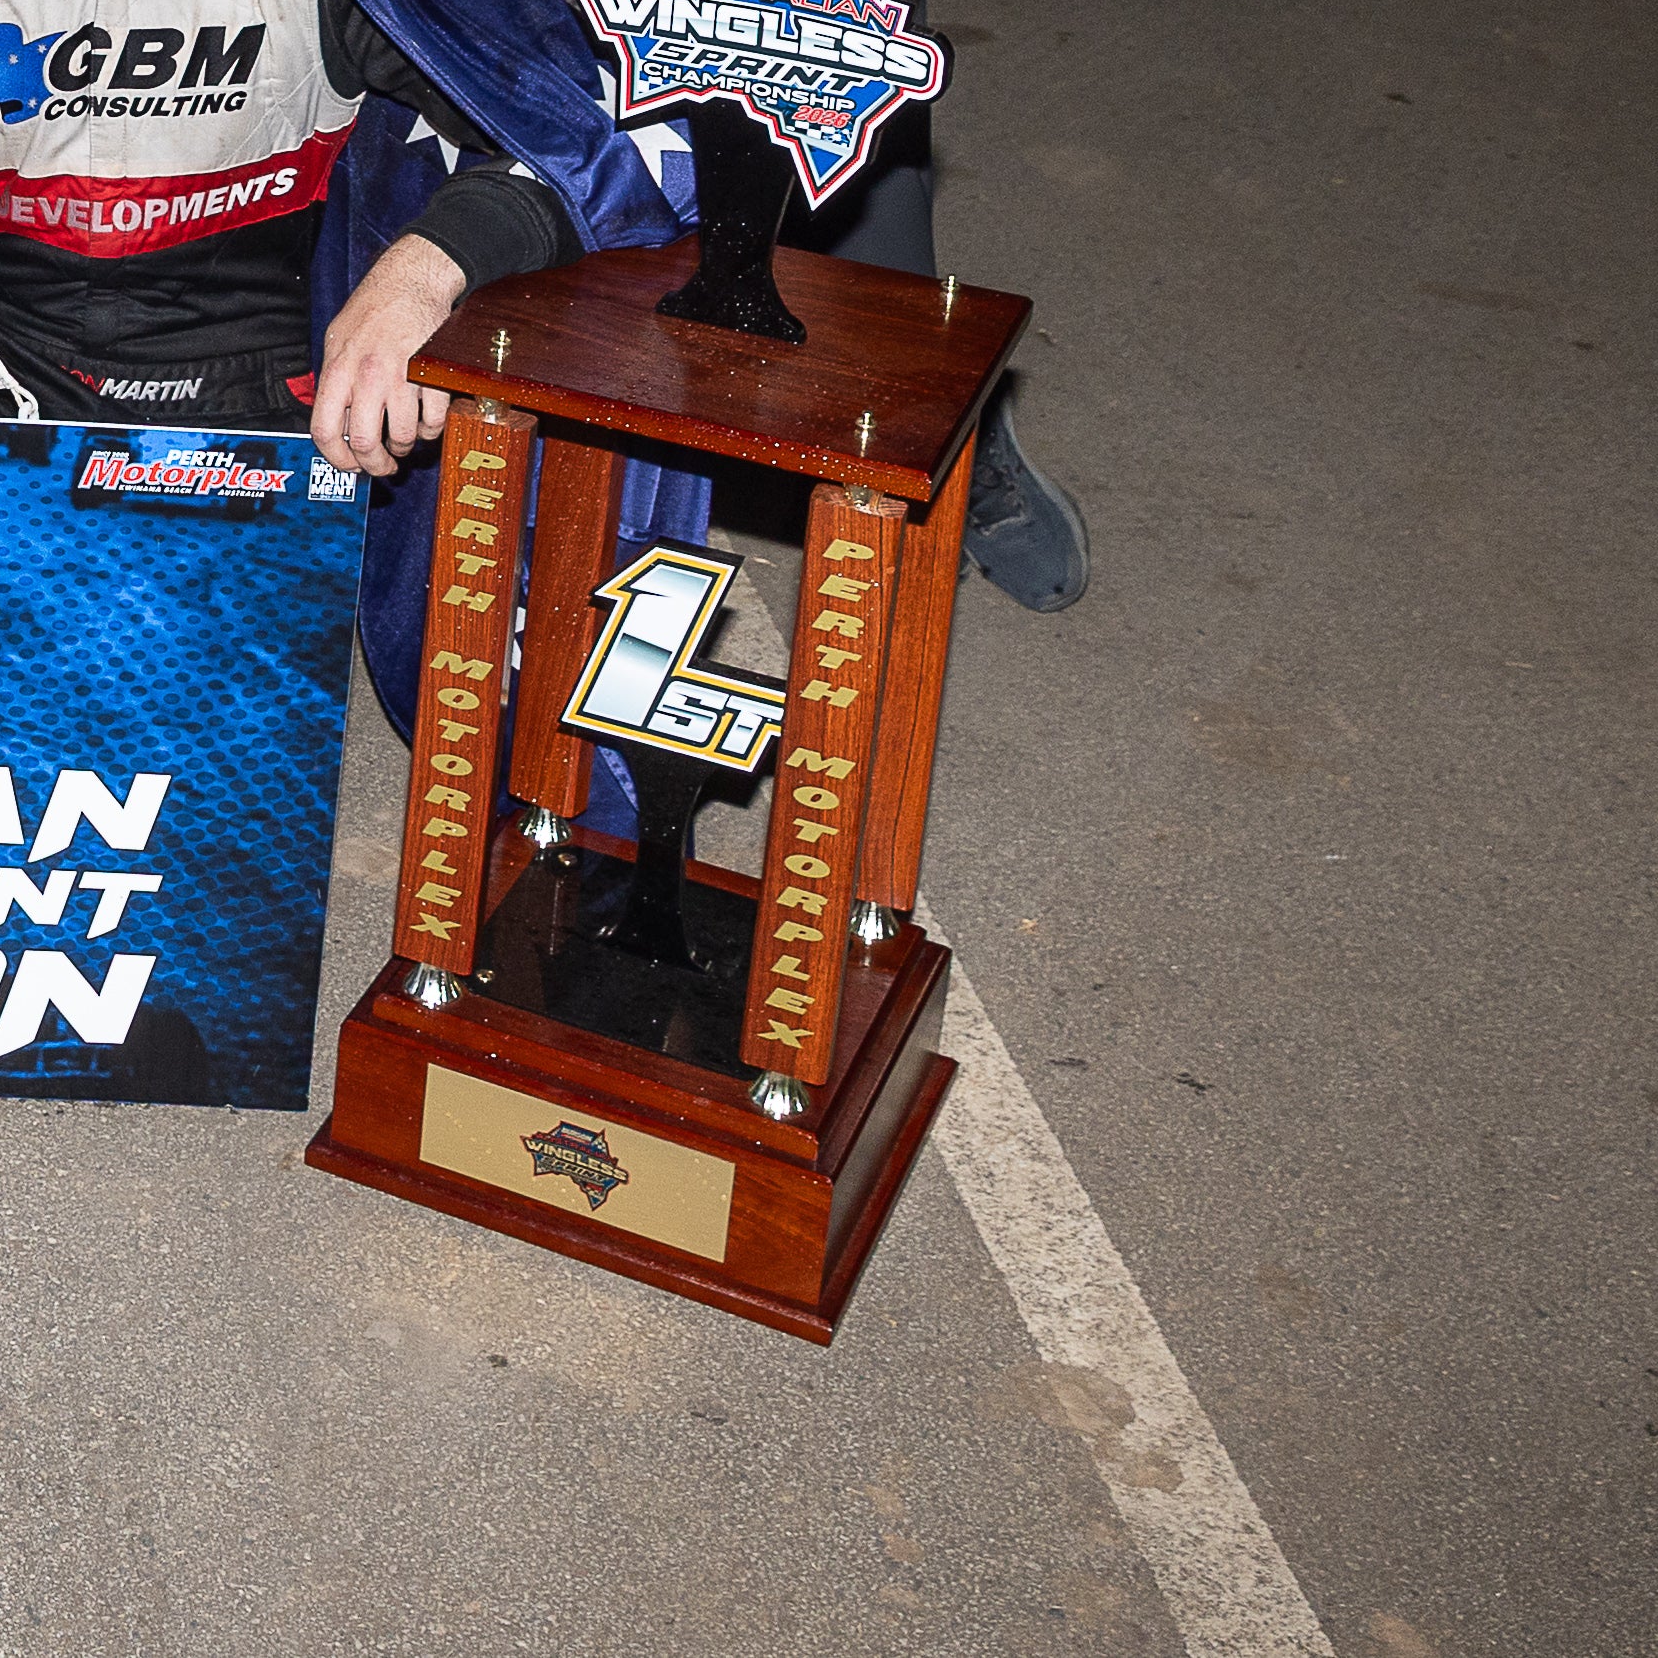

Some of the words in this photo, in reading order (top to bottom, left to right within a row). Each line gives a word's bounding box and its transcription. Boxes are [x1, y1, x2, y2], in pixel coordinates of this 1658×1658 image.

[48, 22, 266, 93] GBM
[645, 39, 872, 96] SPRINT
[44, 90, 249, 121] CONSULTING
[641, 61, 856, 112] CHAMPIONSHIP
[792, 105, 853, 128] 2026
[99, 376, 203, 402] MARTIN
[77, 457, 295, 495] Motorplex
[165, 449, 236, 468] PERTH
[312, 471, 355, 486] TAIN
[118, 484, 163, 494] KWINANA
[163, 485, 193, 494] BEACH
[217, 488, 266, 498] AUSTRALIA
[310, 483, 354, 496] MENT
[440, 448, 508, 614] PERTH
[798, 538, 875, 710] PERTH
[415, 649, 495, 942] MOTORPLEX
[756, 746, 857, 1050] MOTORPLEX
[524, 1138, 628, 1183] WINGLESS
